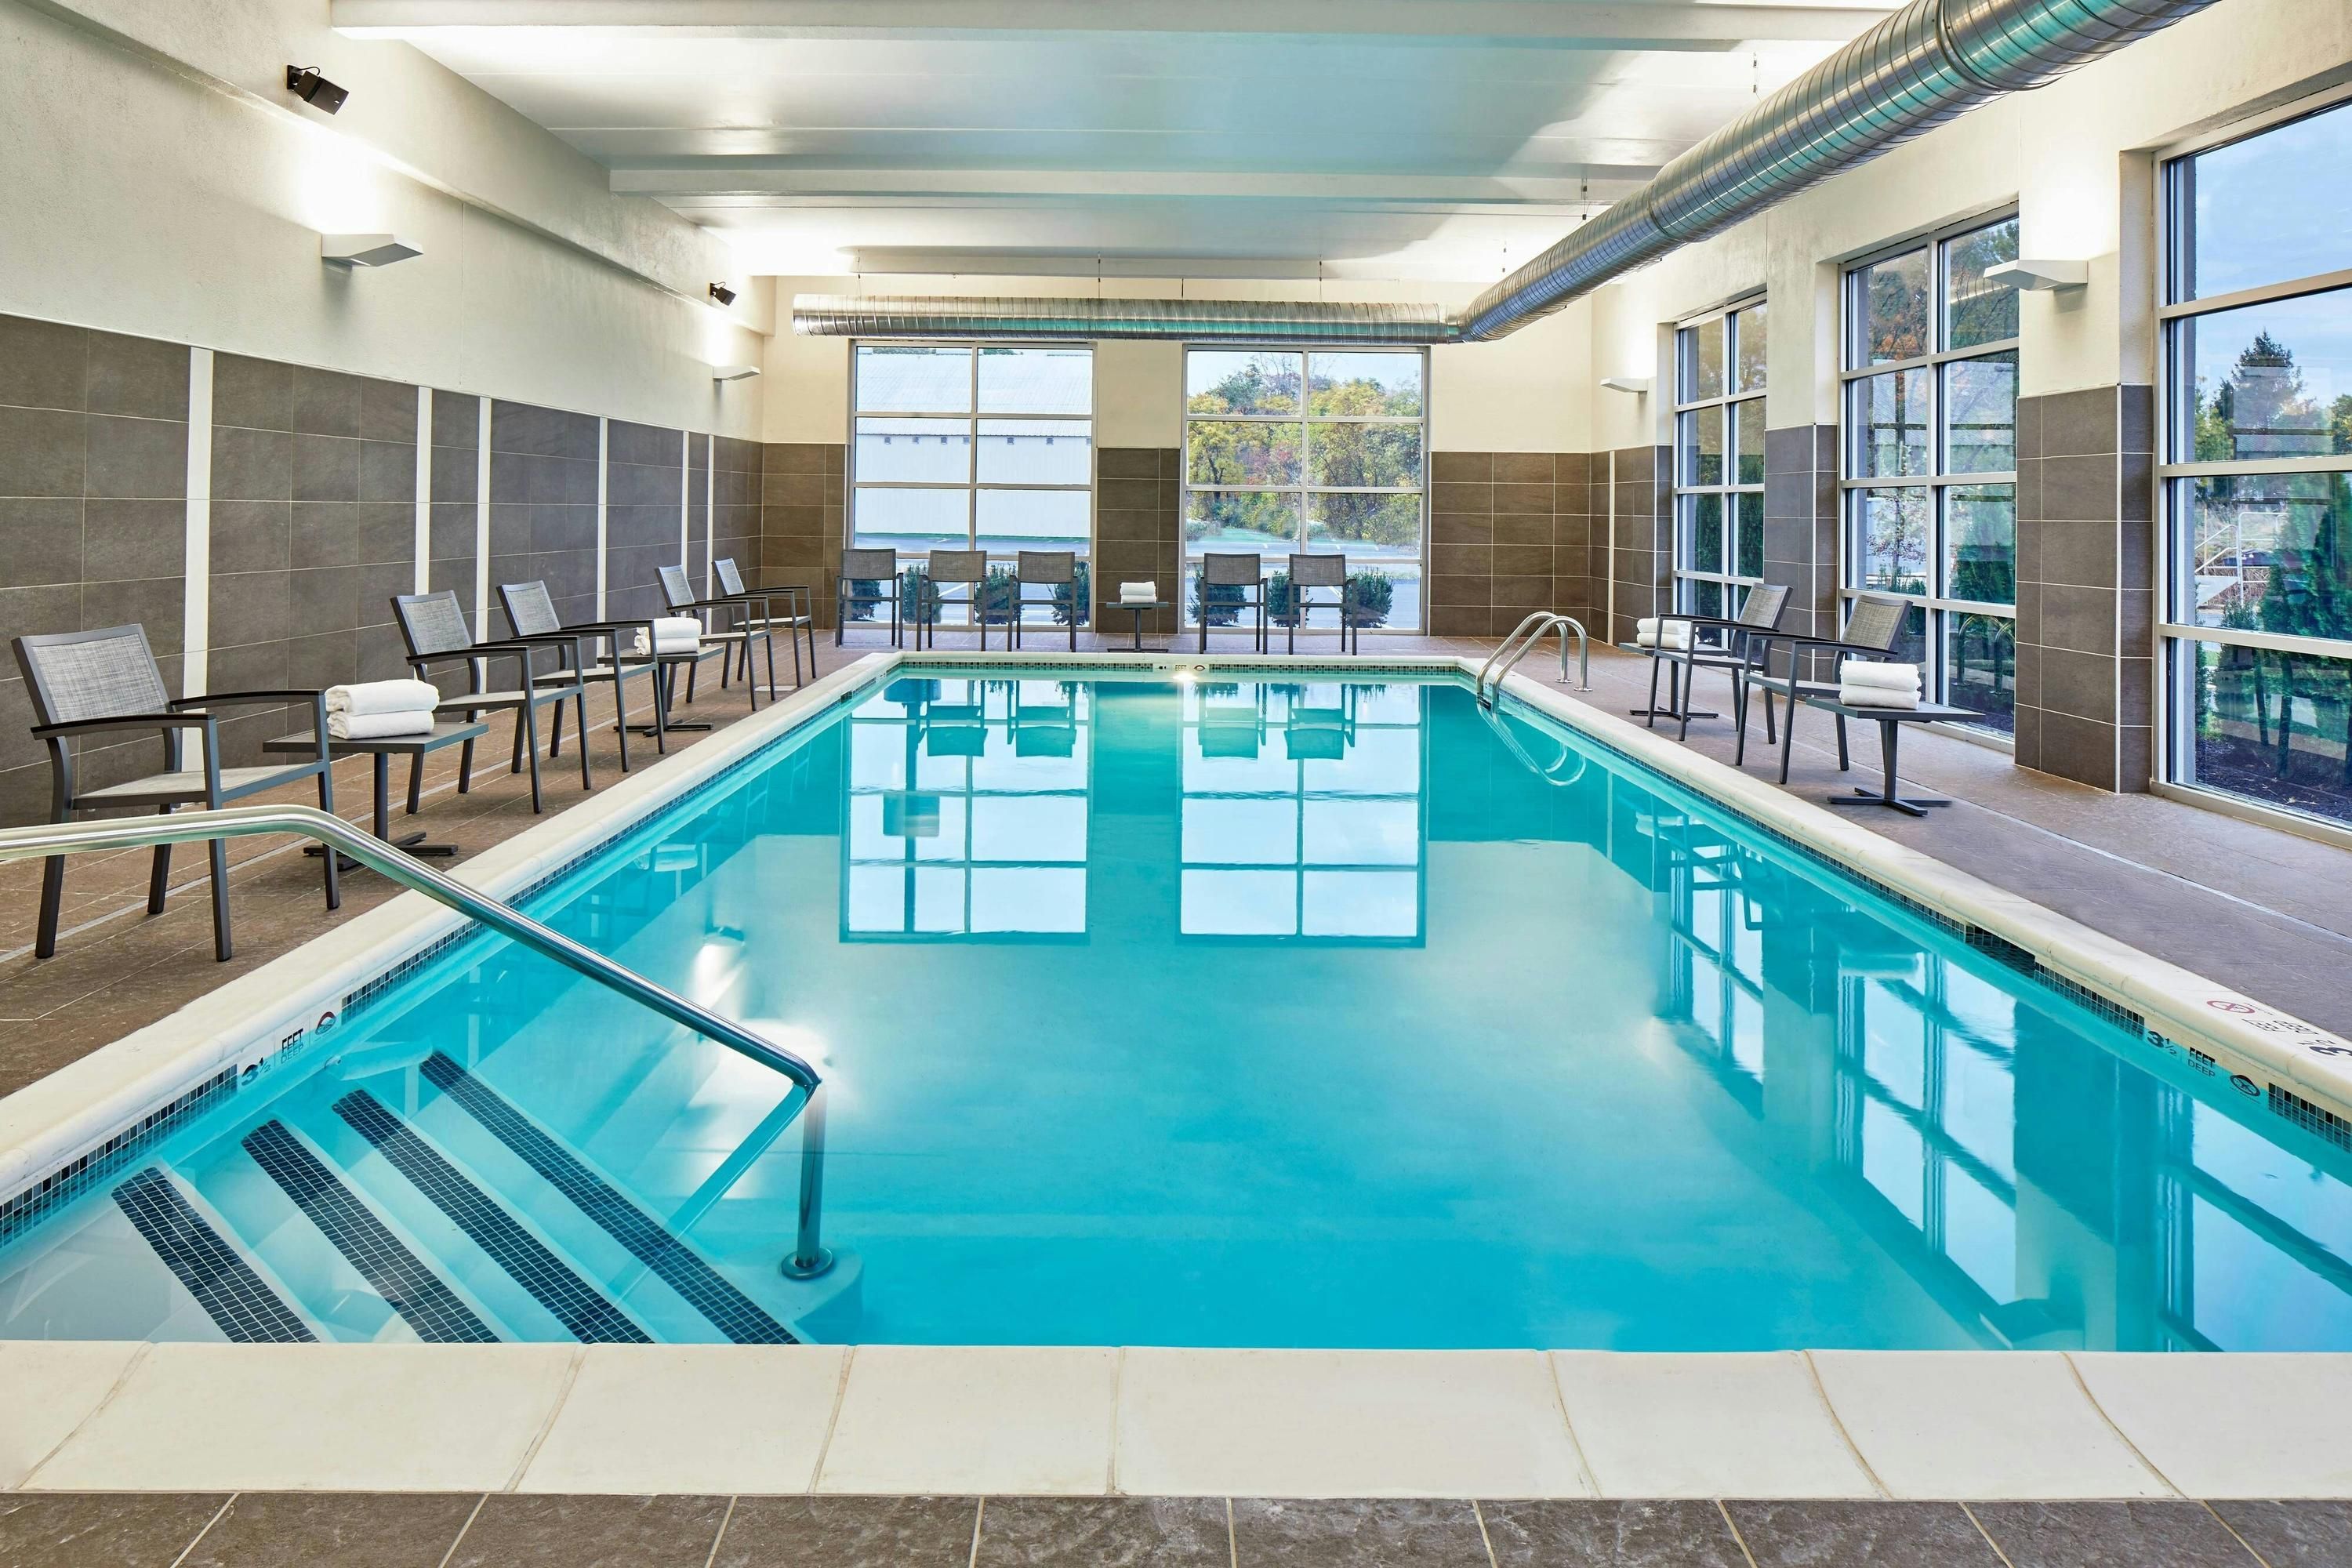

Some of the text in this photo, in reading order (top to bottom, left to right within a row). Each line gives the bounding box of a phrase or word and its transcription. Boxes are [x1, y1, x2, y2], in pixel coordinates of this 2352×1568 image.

[281, 1028, 304, 1054] FEET
[281, 1043, 304, 1064] DEEP
[2189, 1047, 2216, 1068] FEET
[2187, 1058, 2216, 1077] DEEP
